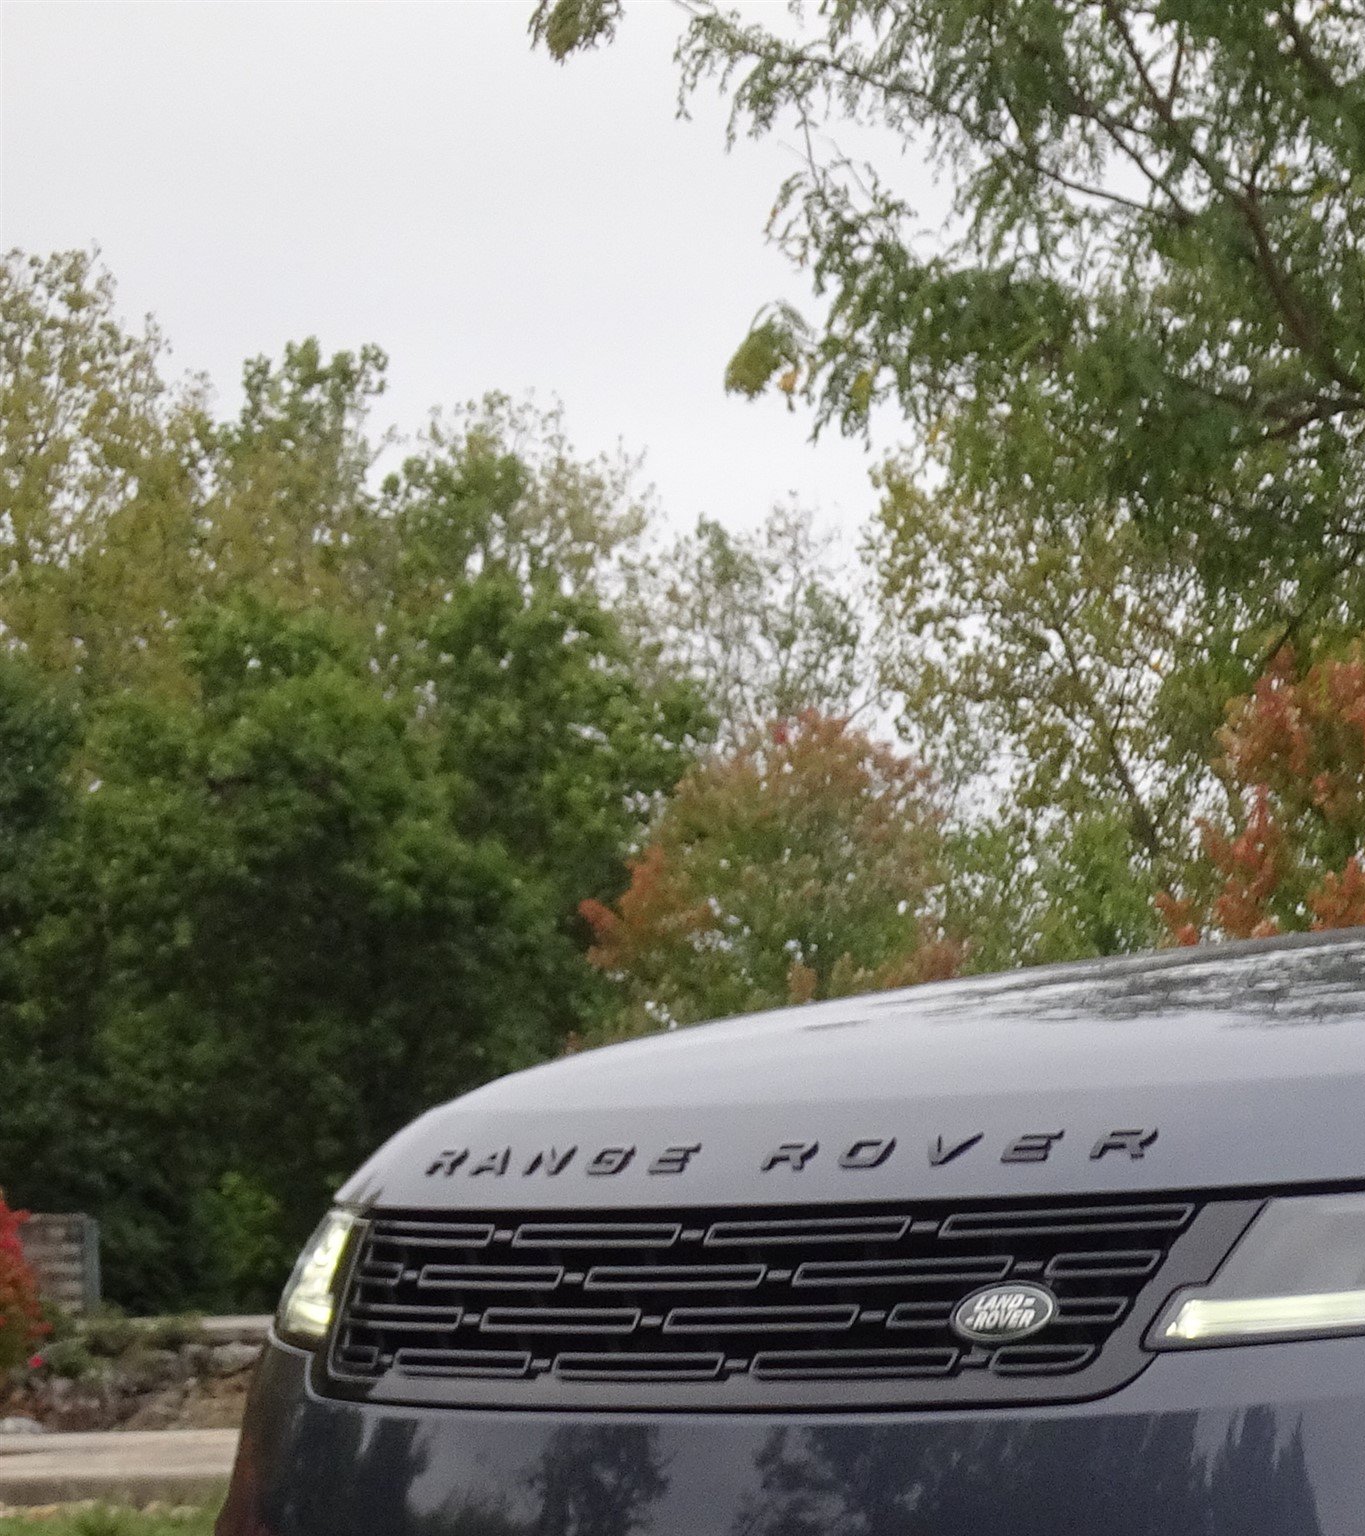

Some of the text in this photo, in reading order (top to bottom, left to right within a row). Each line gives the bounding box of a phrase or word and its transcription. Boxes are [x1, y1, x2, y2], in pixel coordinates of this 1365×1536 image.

[425, 1127, 1160, 1176] RANGE ROVER
[973, 1293, 1025, 1312] LAND
[972, 1309, 1036, 1331] ROVER
